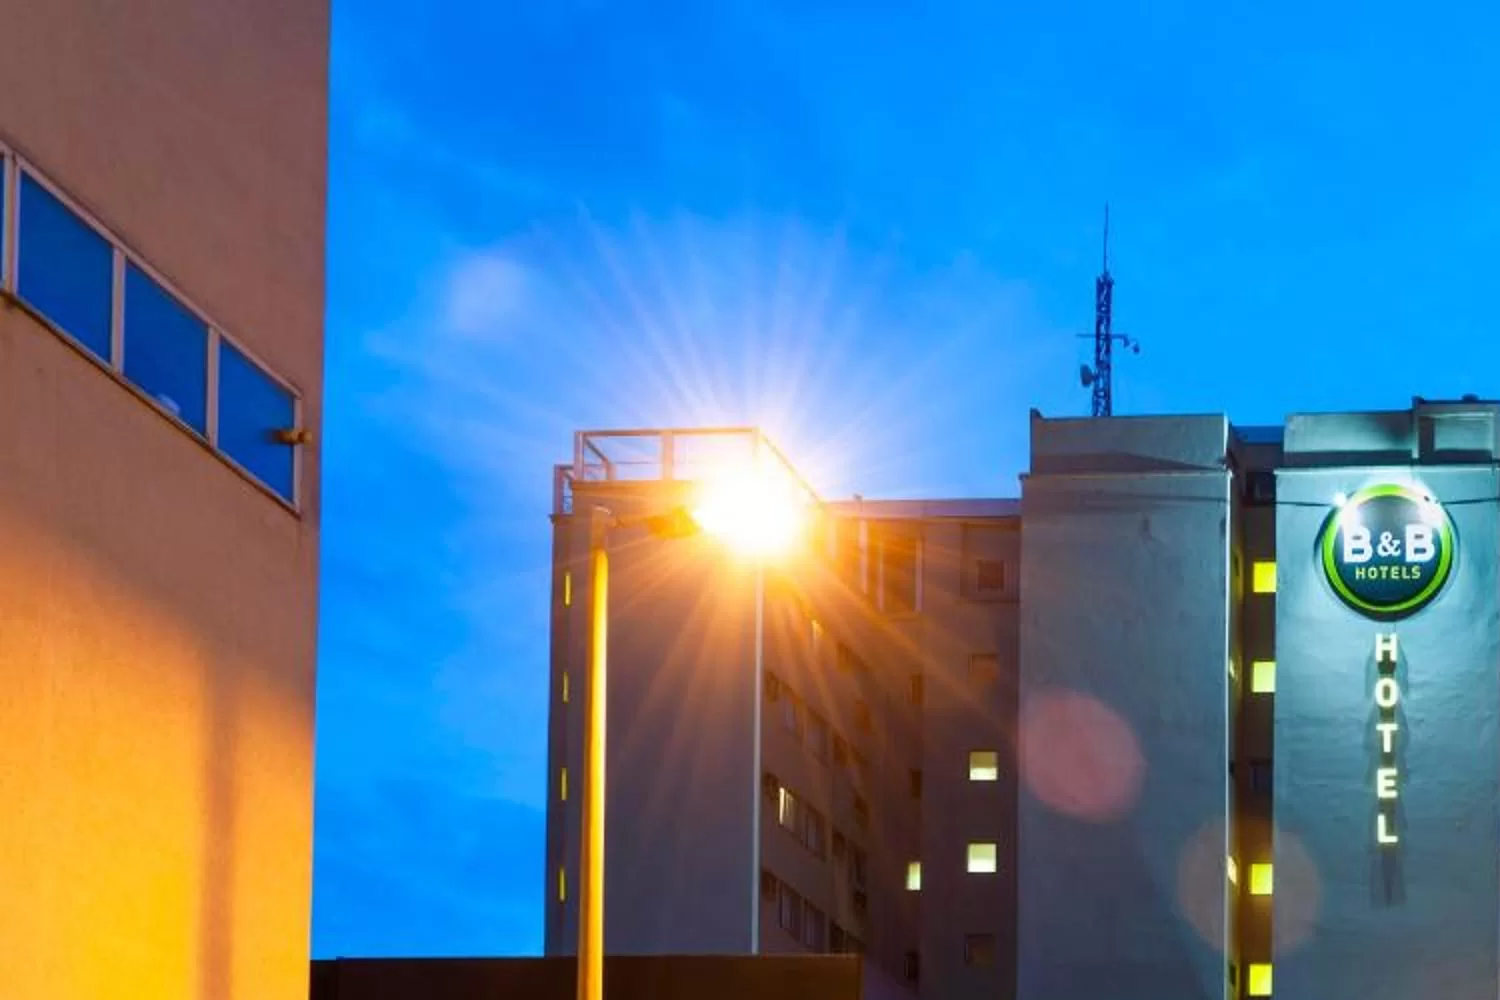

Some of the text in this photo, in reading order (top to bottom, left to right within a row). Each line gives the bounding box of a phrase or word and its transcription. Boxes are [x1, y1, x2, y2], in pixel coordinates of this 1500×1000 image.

[1342, 522, 1436, 563] B&B
[1355, 565, 1422, 580] HOTELS
[1374, 632, 1399, 844] HOTEL
